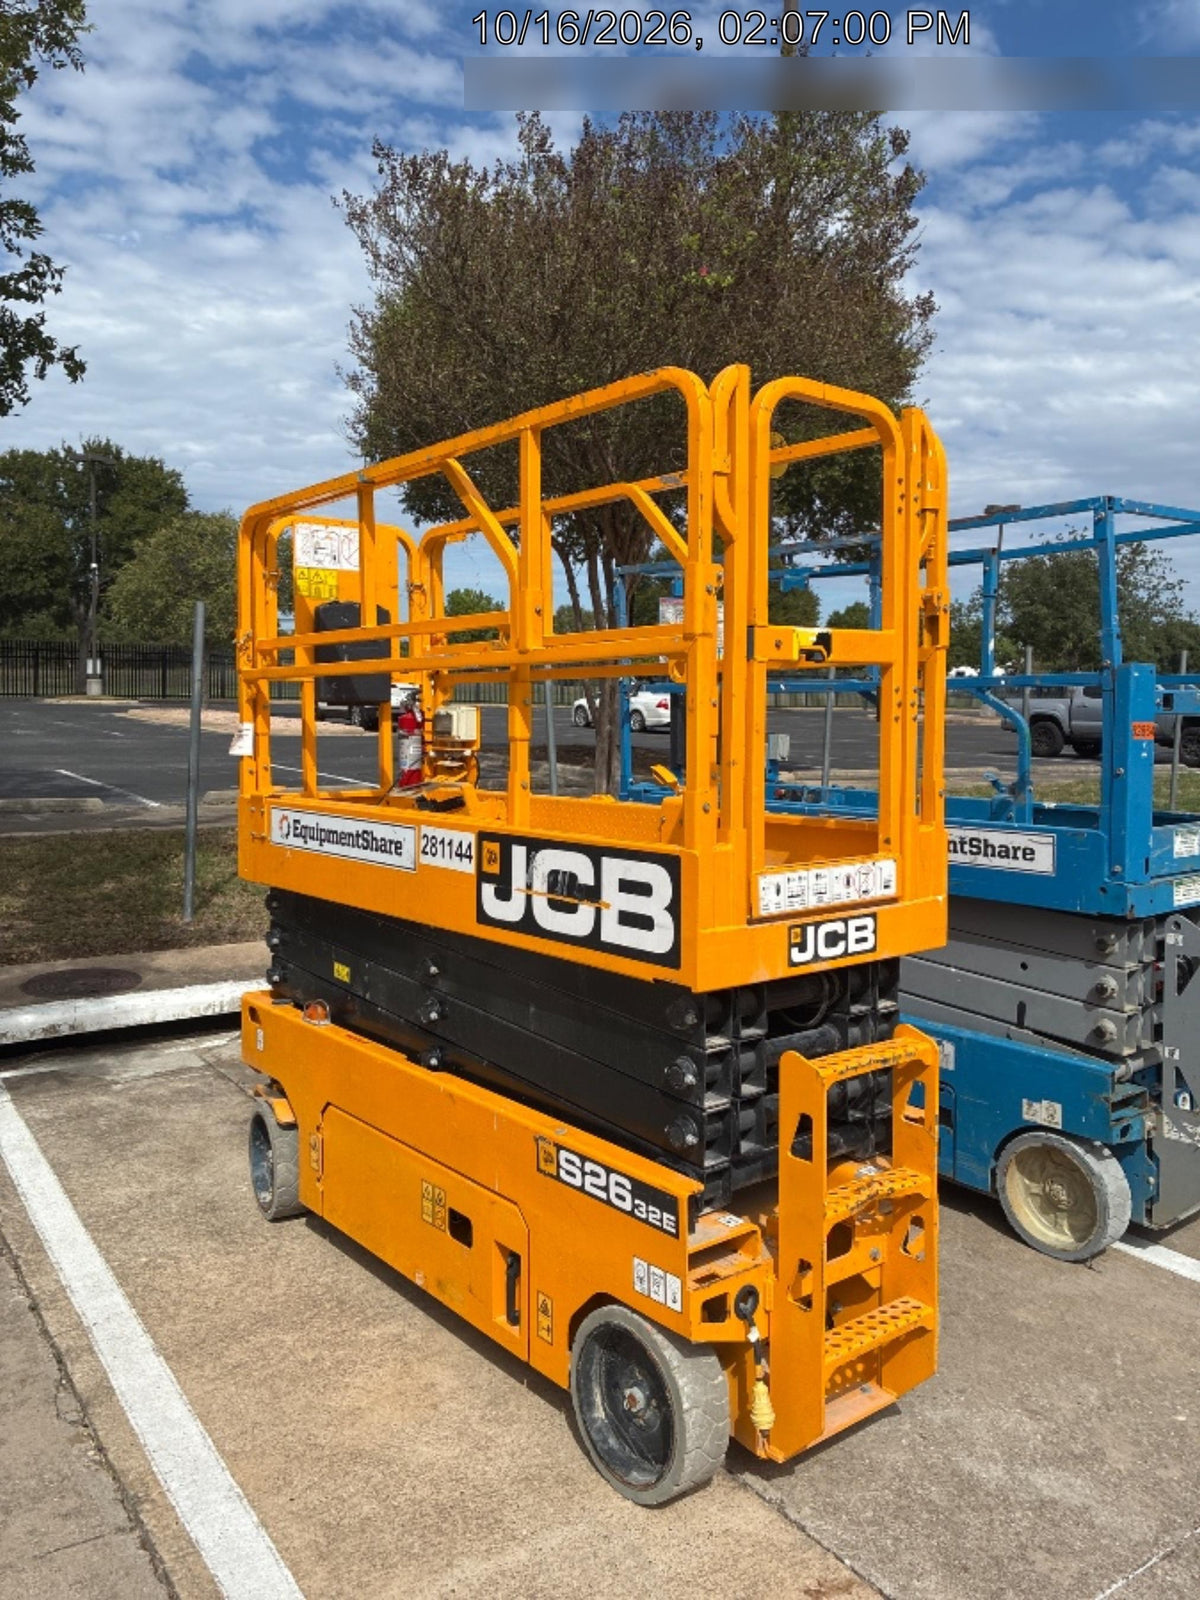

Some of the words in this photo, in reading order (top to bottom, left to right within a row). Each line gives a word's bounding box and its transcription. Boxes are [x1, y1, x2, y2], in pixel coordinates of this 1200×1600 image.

[293, 819, 403, 857] EquipmentShare
[421, 833, 473, 864] 281144
[481, 844, 675, 954] JCB
[790, 916, 876, 963] JCB
